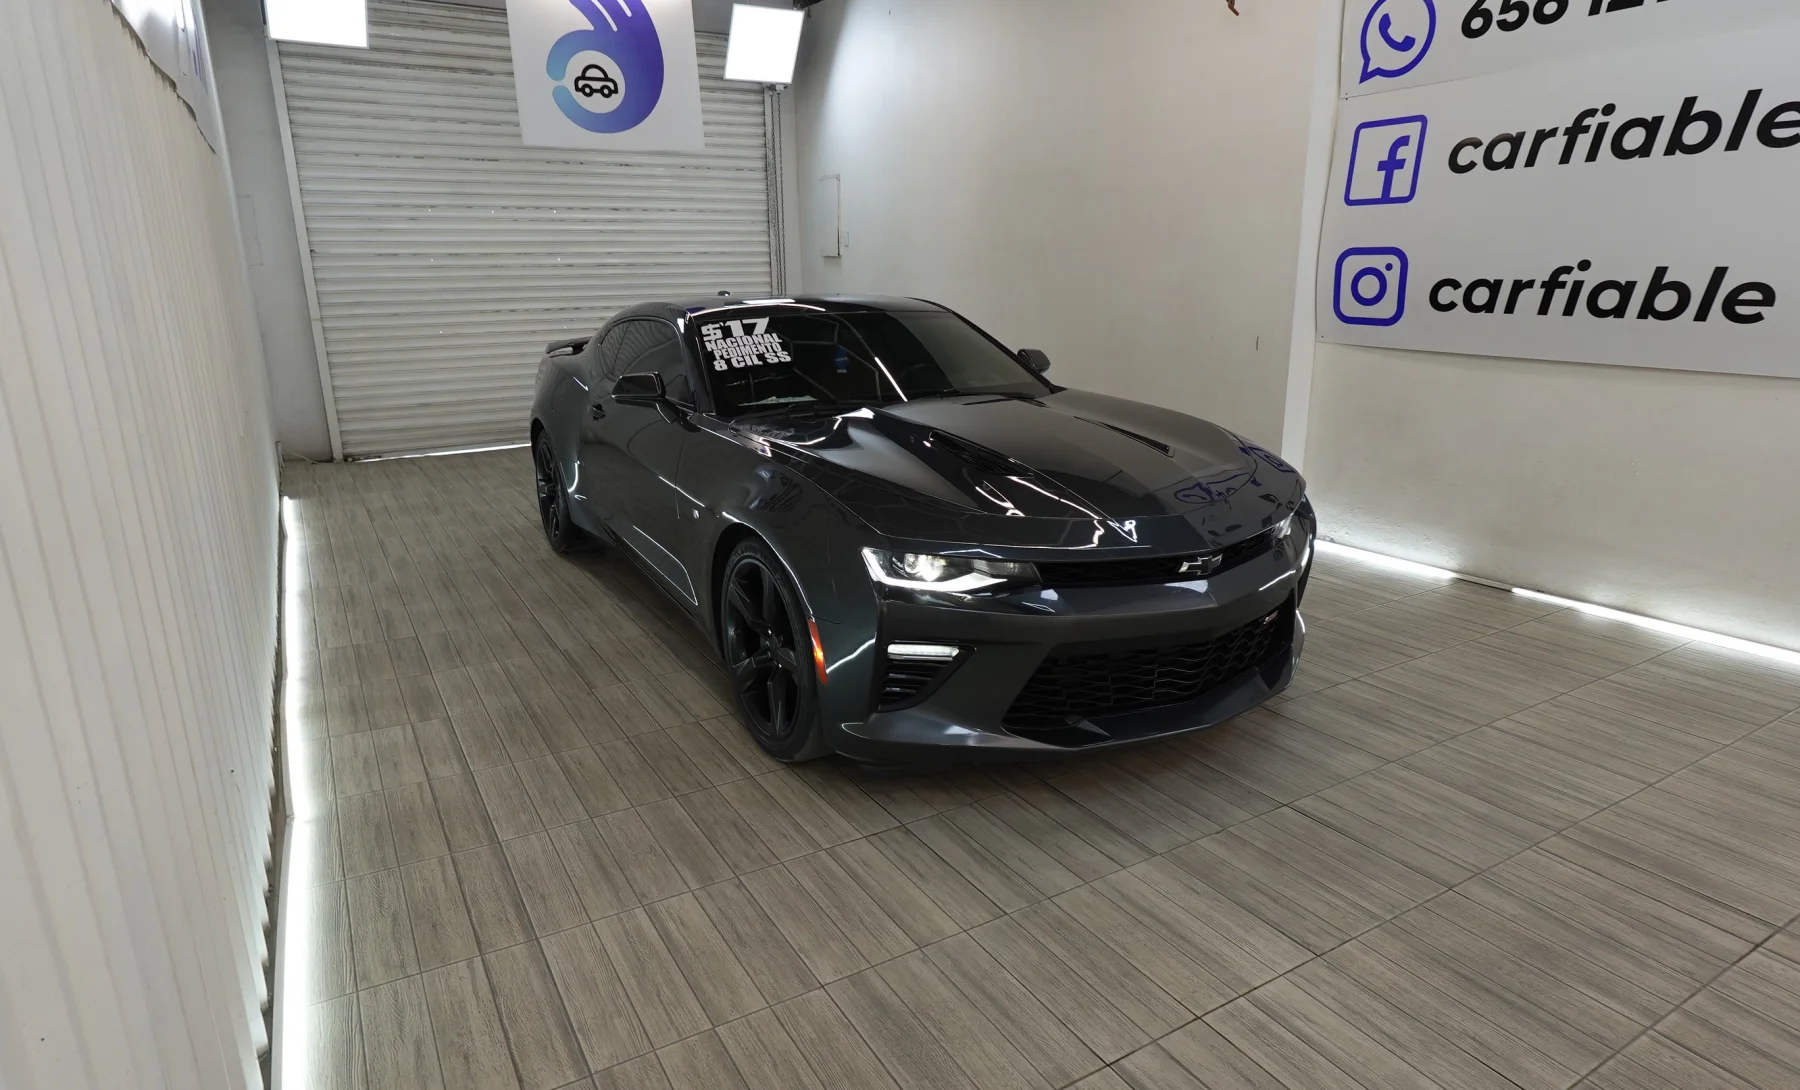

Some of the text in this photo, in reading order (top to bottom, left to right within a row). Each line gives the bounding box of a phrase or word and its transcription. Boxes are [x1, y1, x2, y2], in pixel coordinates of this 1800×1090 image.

[1448, 88, 1800, 175] carfiable
[1428, 259, 1777, 325] carfiable
[704, 332, 783, 352] NACIONAL
[713, 342, 783, 361] PEDIMENTO
[713, 350, 792, 371] 8 CIL SS
